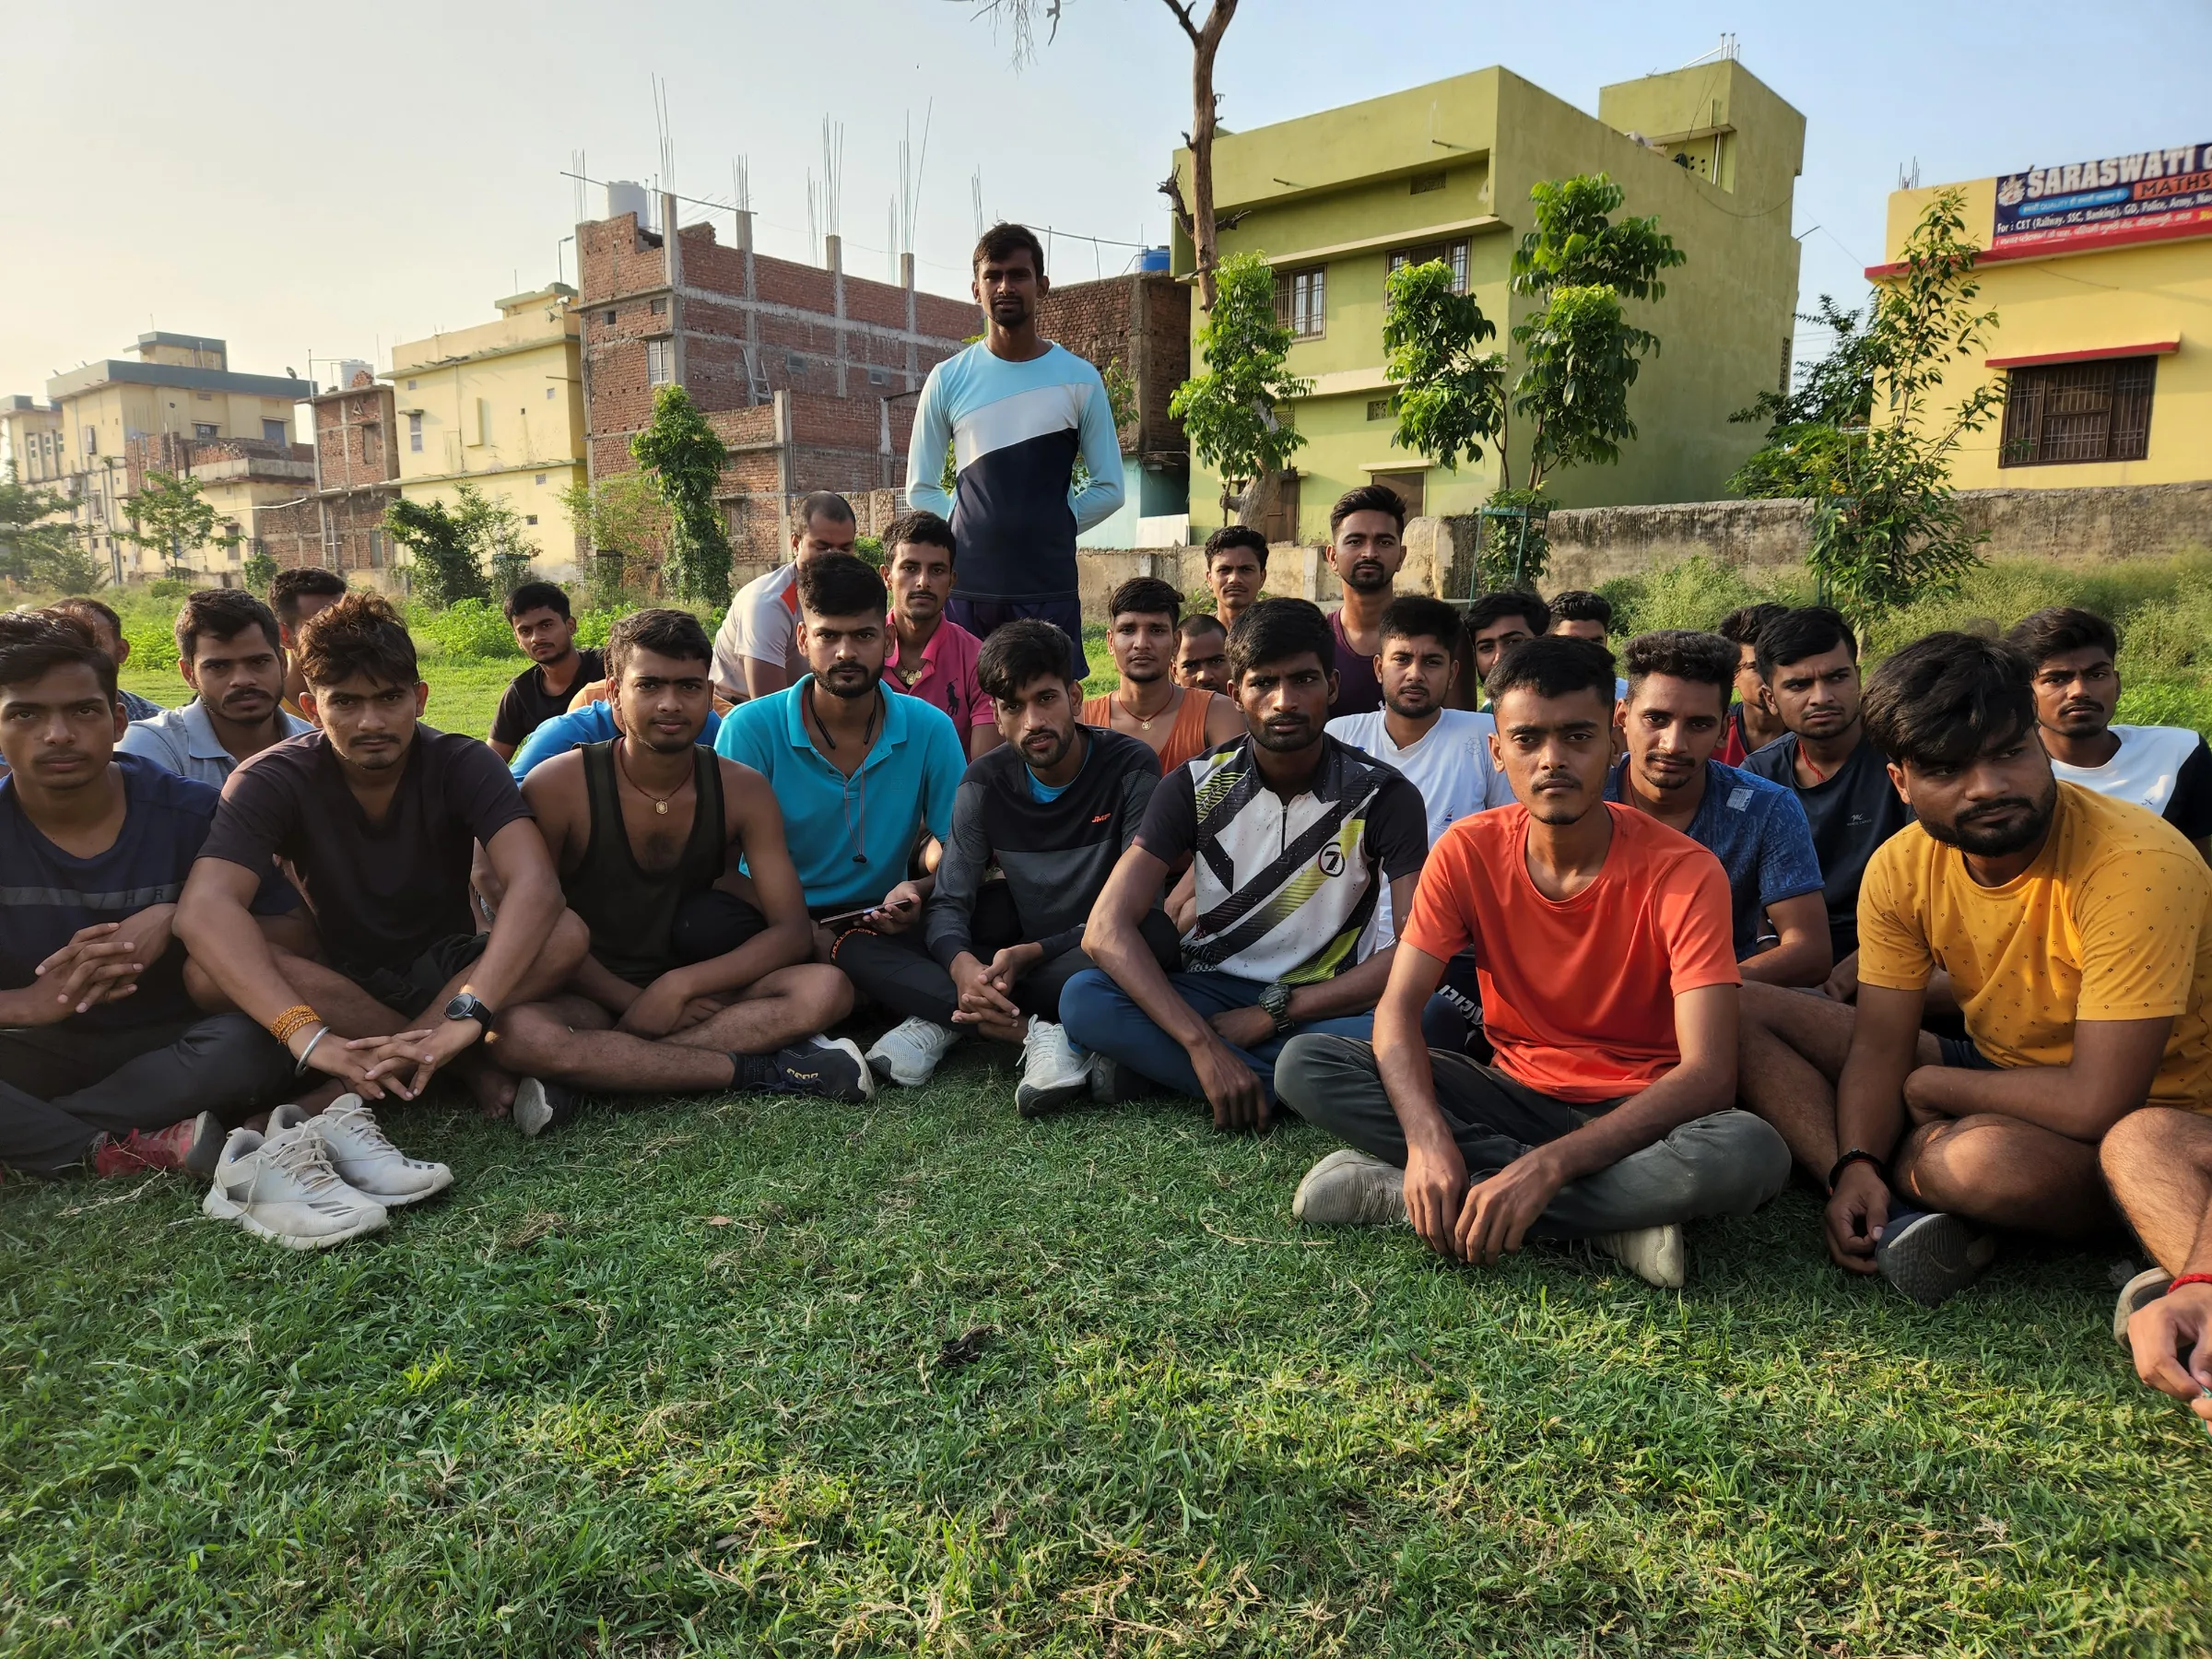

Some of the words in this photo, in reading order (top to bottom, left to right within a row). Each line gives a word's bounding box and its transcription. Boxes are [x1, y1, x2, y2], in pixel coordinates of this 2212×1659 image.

[2028, 145, 2196, 199] SARASWATI
[2141, 171, 2212, 197] MATHS
[2040, 200, 2069, 210] QUALITY
[1997, 223, 2008, 233] For
[2016, 218, 2031, 229] CET
[1324, 851, 1340, 871] 7
